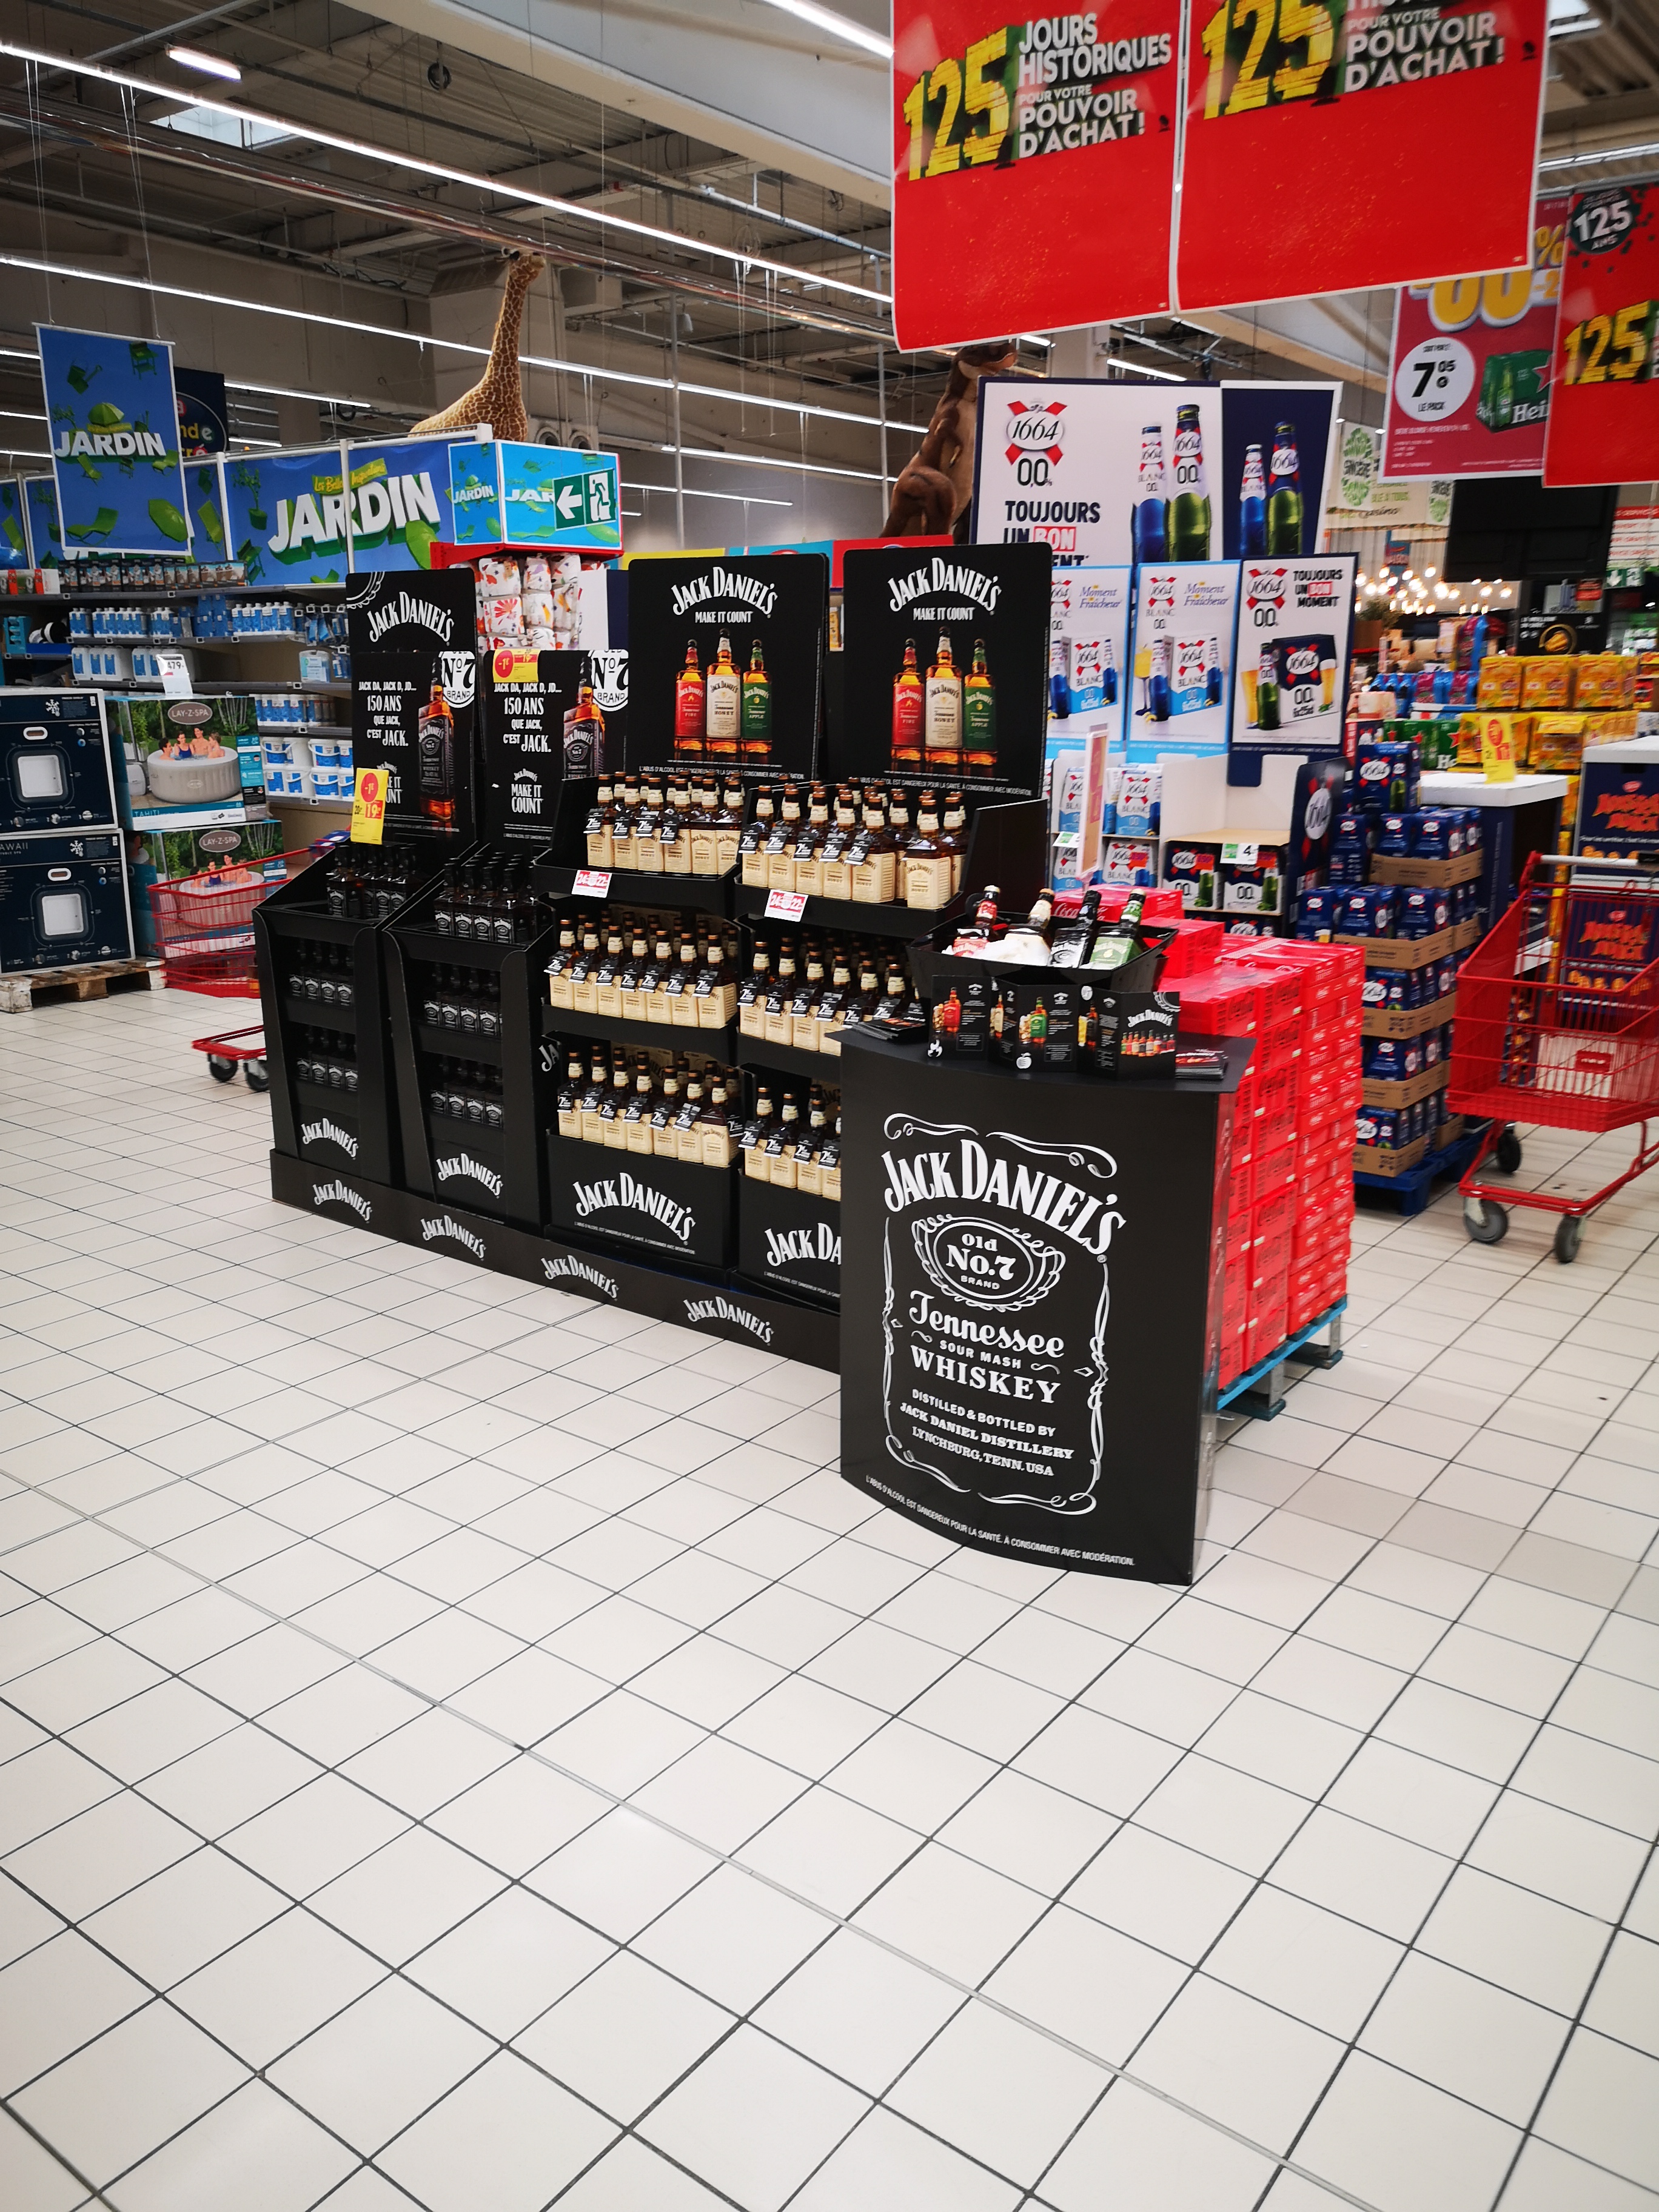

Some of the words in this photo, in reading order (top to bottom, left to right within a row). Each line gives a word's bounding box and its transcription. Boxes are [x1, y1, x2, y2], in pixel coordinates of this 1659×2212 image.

[1347, 15, 1389, 32] POUR
[1393, 7, 1441, 25] VOTRE
[1019, 13, 1098, 53] JOURS
[1347, 11, 1496, 62] POUVOIR
[1019, 33, 1171, 87] HISTORIQUES
[1201, 0, 1333, 119] 125
[1019, 90, 1051, 106] POUR
[1054, 84, 1092, 100] VOTRE
[903, 27, 1009, 181] 125
[1019, 89, 1137, 132] POUVOIR
[1573, 199, 1632, 242] 125
[1563, 300, 1651, 386] 125
[1412, 362, 1436, 398] 7
[1011, 417, 1059, 440] 1664
[53, 431, 167, 457] JARDIN
[1175, 437, 1201, 452] 1664
[1271, 452, 1298, 468] 1664
[452, 485, 494, 503] JARDIN
[267, 472, 441, 554] JARDIN
[1005, 500, 1101, 523] TOUJOURS
[1034, 527, 1074, 551] BON
[1293, 569, 1342, 581] TOUJOURS
[671, 575, 712, 615] JACK
[712, 566, 778, 615] DANIEL'S
[888, 568, 931, 612] JACK
[931, 557, 1002, 611] DANIEL'S
[1079, 586, 1118, 597] Moment
[1151, 584, 1173, 596] 1664
[1184, 583, 1225, 594] Moment
[1251, 578, 1284, 594] 1664
[1295, 584, 1308, 595] UN
[1079, 598, 1121, 608] Fraîcheur
[1184, 595, 1229, 606] Fraîcheur
[1297, 596, 1341, 608] MOMENT
[367, 601, 401, 643] JACK
[399, 591, 455, 643] DANIEL'S
[695, 611, 717, 623] MAKE
[717, 611, 726, 623] IT
[726, 611, 754, 623] COUNT
[913, 608, 936, 620] MAKE
[937, 608, 947, 620] IT
[947, 608, 976, 620] COUNT
[1078, 650, 1098, 662] 1664
[1182, 649, 1203, 663] 1664
[1289, 653, 1318, 671] 1664
[358, 682, 372, 691] JACK
[372, 682, 382, 692] DA,
[383, 682, 396, 691] JACK
[494, 683, 509, 692] JACK
[510, 683, 521, 694] DA,
[522, 683, 538, 692] JACK
[1076, 674, 1103, 686] BLANC
[1178, 675, 1207, 687] BLANC
[367, 695, 383, 711] 150
[383, 695, 401, 712] ANS
[446, 690, 475, 701] BRAND
[597, 692, 626, 703] BRAND
[172, 709, 209, 718] LAY-Z-SPA
[504, 697, 521, 715] 150
[523, 698, 544, 715] ANS
[374, 716, 385, 726] QUE
[386, 716, 401, 726] JACK,
[511, 719, 524, 730] QUE
[525, 719, 543, 731] JACK,
[367, 729, 382, 739] C'EST
[382, 729, 409, 746] JACK.
[503, 734, 520, 744] C'EST
[521, 734, 552, 752] JACK.
[394, 777, 401, 788] IT
[511, 784, 532, 797] MAKE
[534, 785, 542, 797] IT
[1126, 782, 1147, 796] 1664
[134, 809, 159, 817] TAHITI
[512, 797, 544, 814] COUNT
[1121, 803, 1150, 813] BLANC
[203, 836, 238, 846] LAY-Z-SPA
[1173, 853, 1196, 869] 1664
[1107, 871, 1136, 880] BLANC
[1054, 903, 1081, 918] Coca
[1128, 1014, 1145, 1028] JACK
[301, 1122, 323, 1144] JACK
[323, 1118, 359, 1158] DANIEL'S
[436, 1158, 462, 1181] JACK
[461, 1153, 503, 1196] DANIEL'S
[312, 1184, 336, 1205] JACK
[335, 1179, 372, 1221] DANIEL'S
[882, 1151, 959, 1212] JACK
[960, 1139, 1127, 1255] DANIEL'S
[572, 1180, 620, 1216] JACK
[619, 1172, 696, 1241] DANIEL'S
[420, 1218, 446, 1241] JACK
[444, 1215, 486, 1259] DANIEL'S
[962, 1233, 998, 1252] Old
[764, 1228, 817, 1267] JACK
[541, 1257, 569, 1280] JACK
[567, 1255, 619, 1299] DANIEL'S
[961, 1275, 1000, 1289] BRAND
[683, 1299, 719, 1322] JACK
[715, 1296, 774, 1343] DANIEL'S
[910, 1290, 1064, 1358] Tennessee
[940, 1340, 974, 1358] SOUR
[980, 1352, 1021, 1369] MASH
[911, 1345, 1061, 1403] WHISKEY
[912, 1389, 965, 1416] DISTILLED
[967, 1410, 976, 1420] &
[977, 1413, 1035, 1433] BOTTLED
[1038, 1426, 1056, 1437] BY
[900, 1403, 928, 1422] JACK
[930, 1415, 979, 1440] DANIEL
[980, 1433, 1074, 1459] DISTILLERY
[1026, 1463, 1054, 1476] USA
[866, 1475, 882, 1490] L'ABUS
[882, 1485, 906, 1504] D'ALCOOL
[906, 1499, 917, 1510] EST
[917, 1504, 950, 1526] DANGEREUX
[950, 1520, 968, 1533] POUR
[968, 1527, 977, 1537] LA
[1011, 1538, 1061, 1555] CONSOMMER
[1061, 1548, 1082, 1558] AVEC
